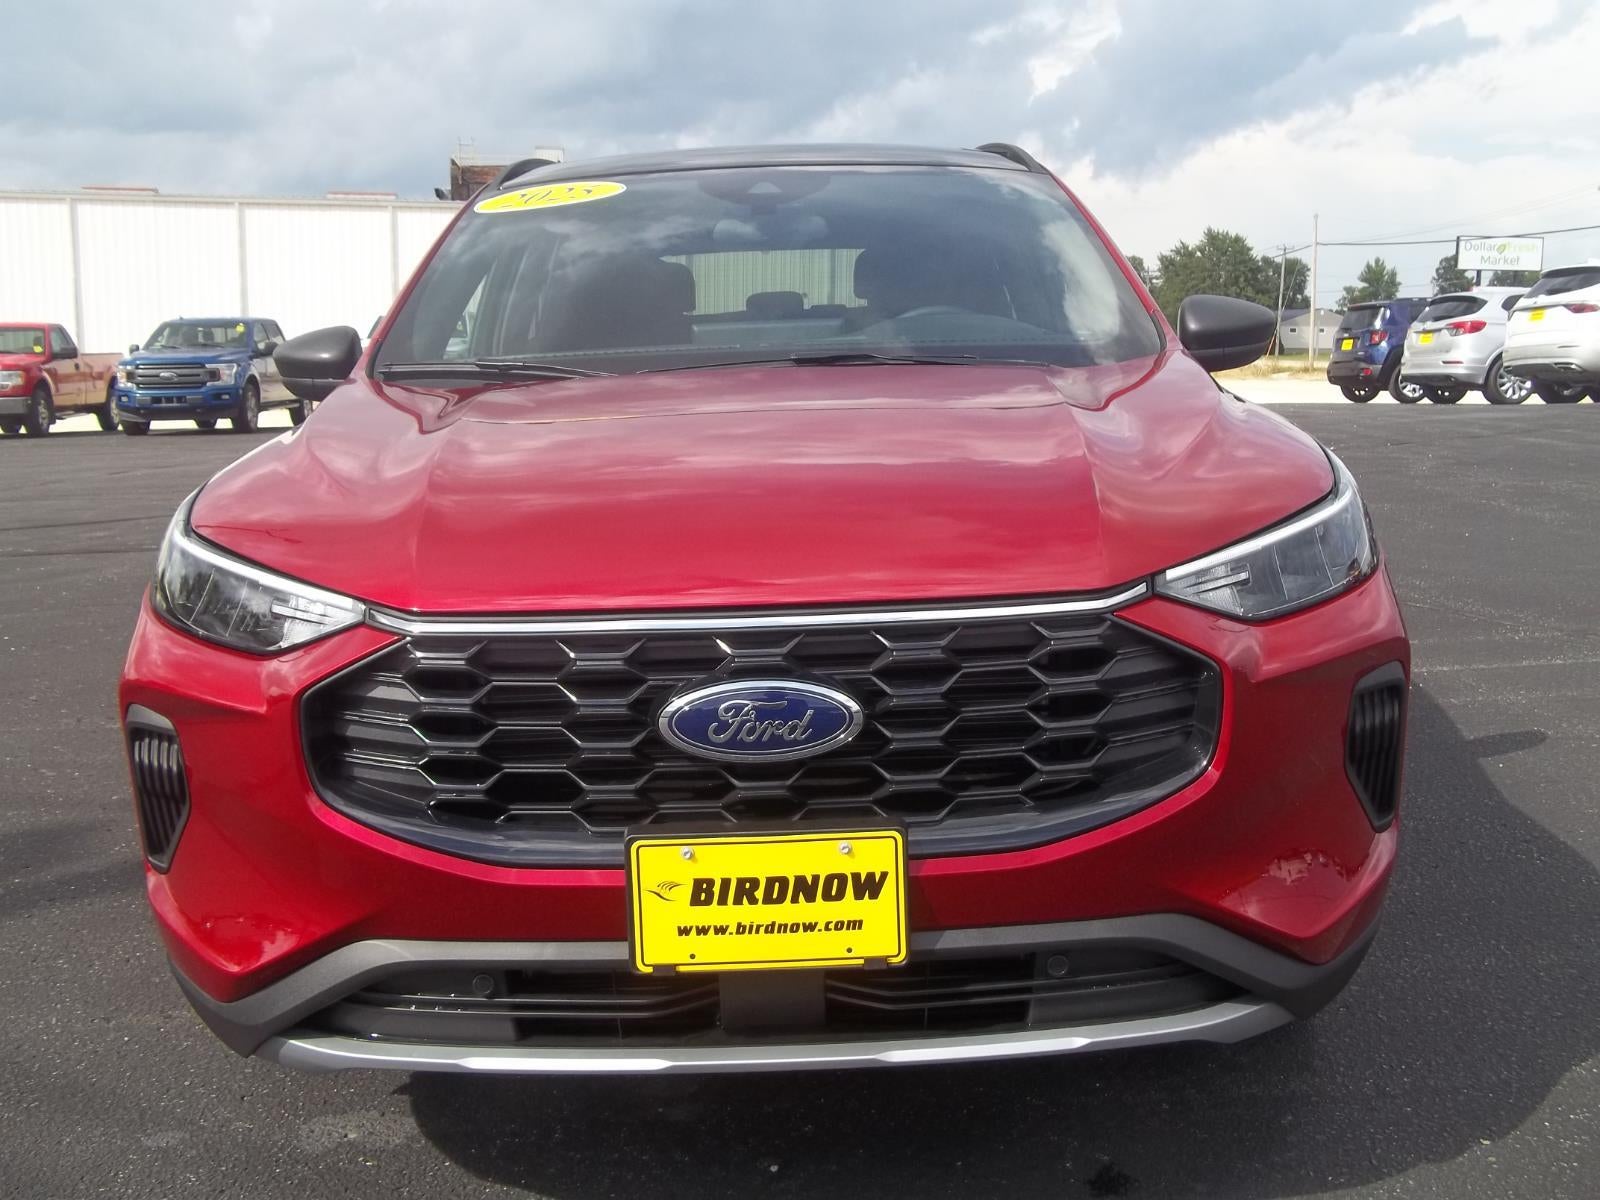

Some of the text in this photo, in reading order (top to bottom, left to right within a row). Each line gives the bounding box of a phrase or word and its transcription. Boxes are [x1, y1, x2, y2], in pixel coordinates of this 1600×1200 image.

[500, 184, 602, 208] 2025
[1464, 240, 1497, 252] Dollar
[1480, 255, 1520, 265] Market
[707, 699, 815, 743] Ford
[689, 870, 889, 907] BIRDNOW
[677, 918, 864, 937] www.birdnow.com
